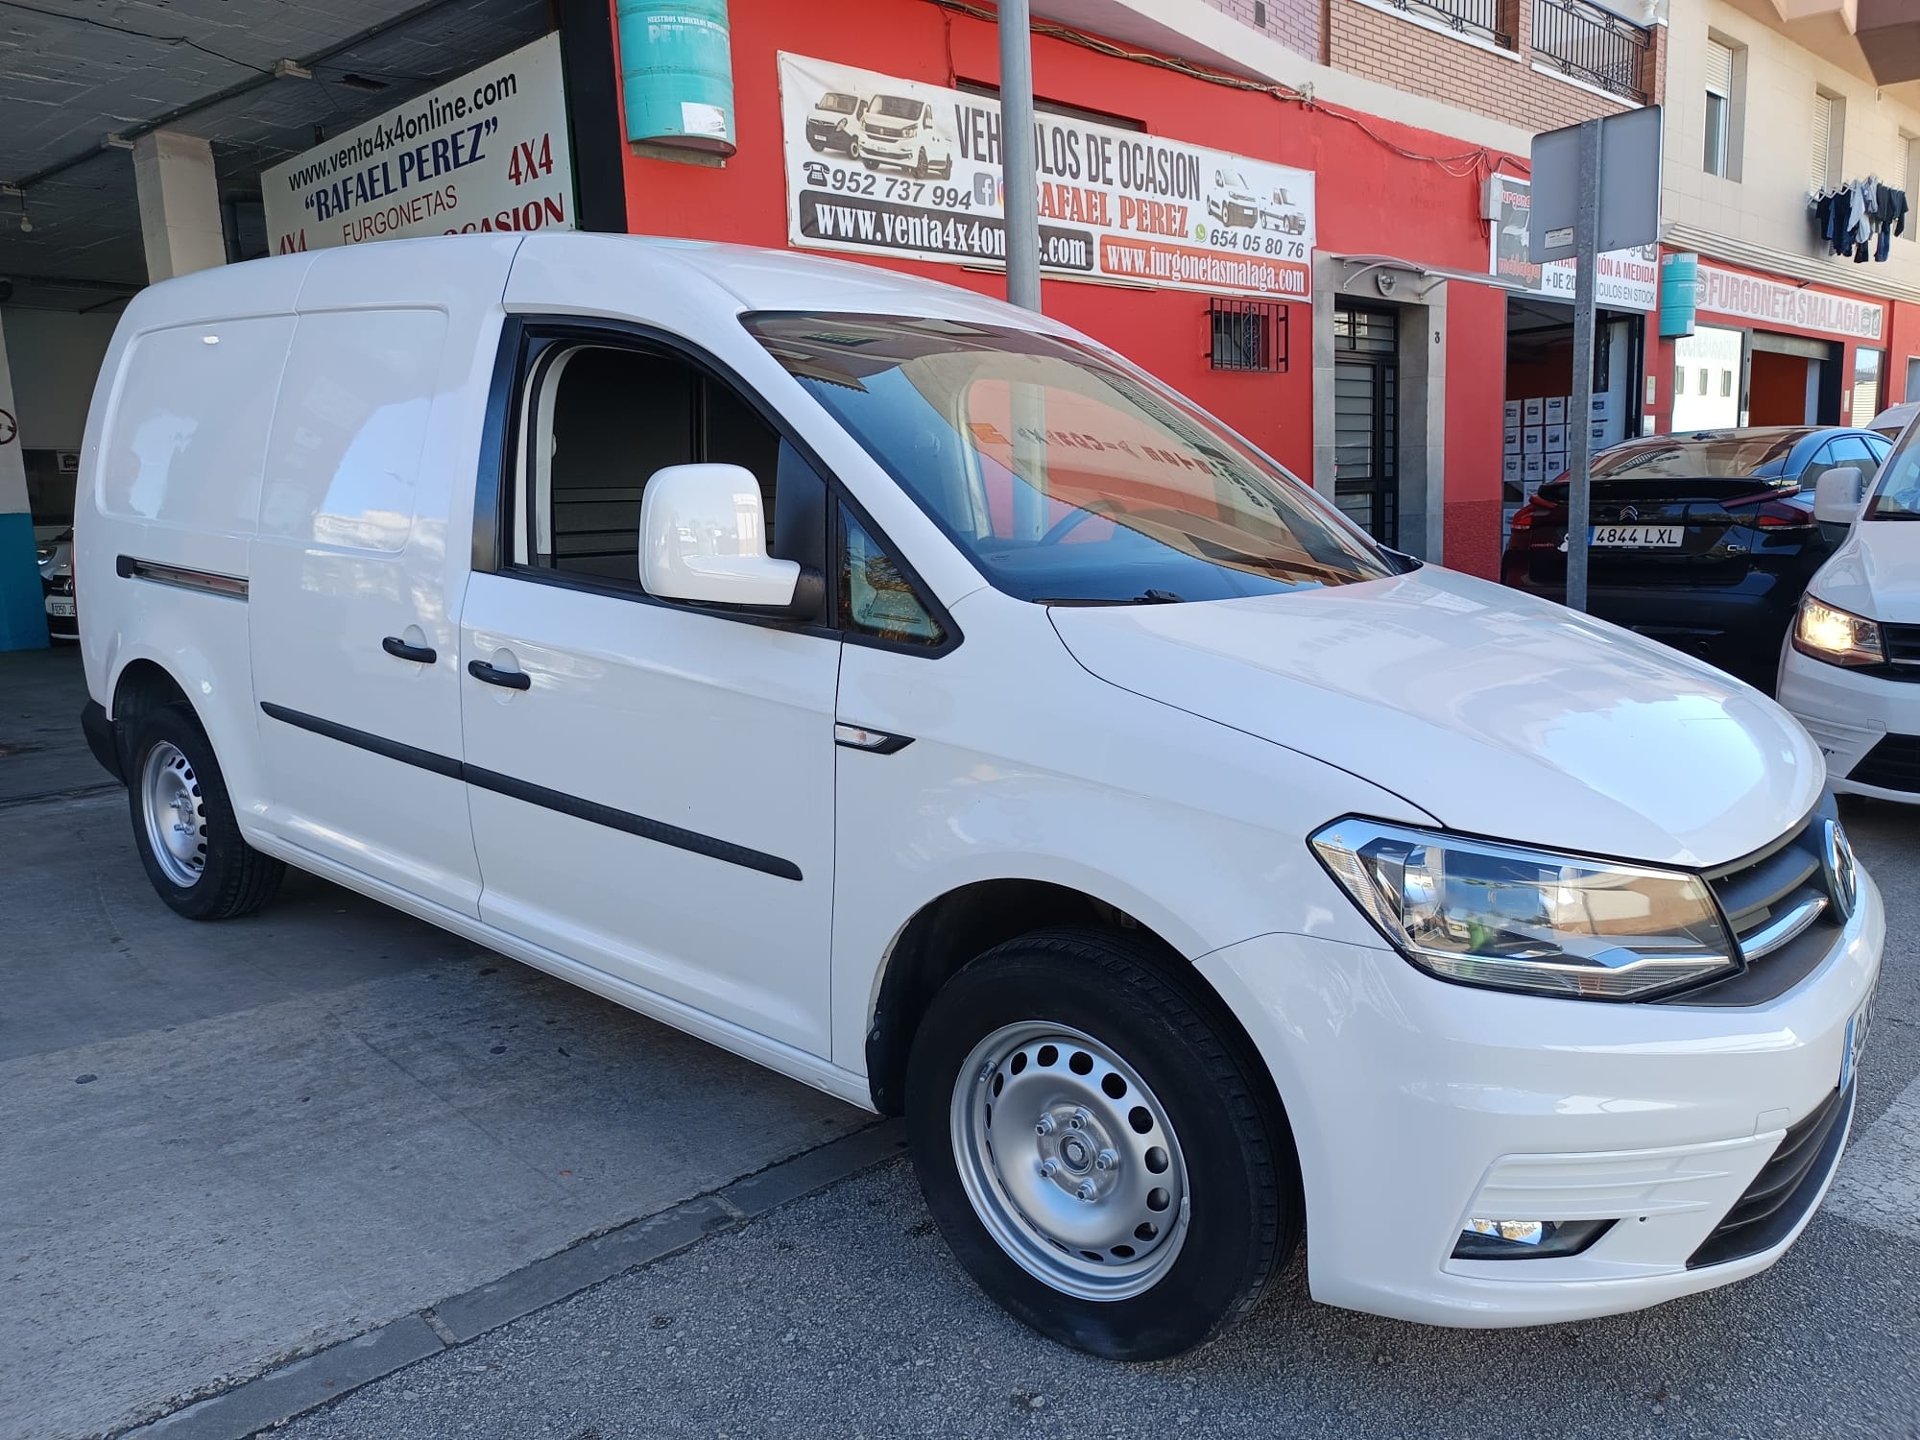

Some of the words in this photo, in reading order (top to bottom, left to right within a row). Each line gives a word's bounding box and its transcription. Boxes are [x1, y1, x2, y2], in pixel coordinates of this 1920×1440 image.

[288, 73, 517, 191] www.venta4x4online.com
[508, 133, 553, 186] 4X4
[1086, 133, 1113, 185] DE
[1119, 140, 1200, 201] OCASION
[831, 168, 877, 196] 952
[885, 177, 925, 203] 737
[932, 185, 972, 211] 994
[1037, 181, 1112, 227] AFAEL
[1118, 195, 1188, 238] PEREZ
[343, 185, 457, 246] FURGONETAS
[1106, 244, 1305, 293] www.furgonetasmalaga.com
[1210, 229, 1238, 248] 654
[1242, 234, 1261, 252] 05
[1265, 237, 1283, 255] 80
[1288, 241, 1304, 259] 76
[1553, 272, 1563, 289] DE
[1624, 286, 1632, 300] EN
[1634, 289, 1655, 305] STOCK
[1615, 261, 1622, 278] A
[1624, 262, 1654, 284] MEDIDA
[1596, 528, 1637, 543] 4844
[1644, 529, 1677, 544] LXL
